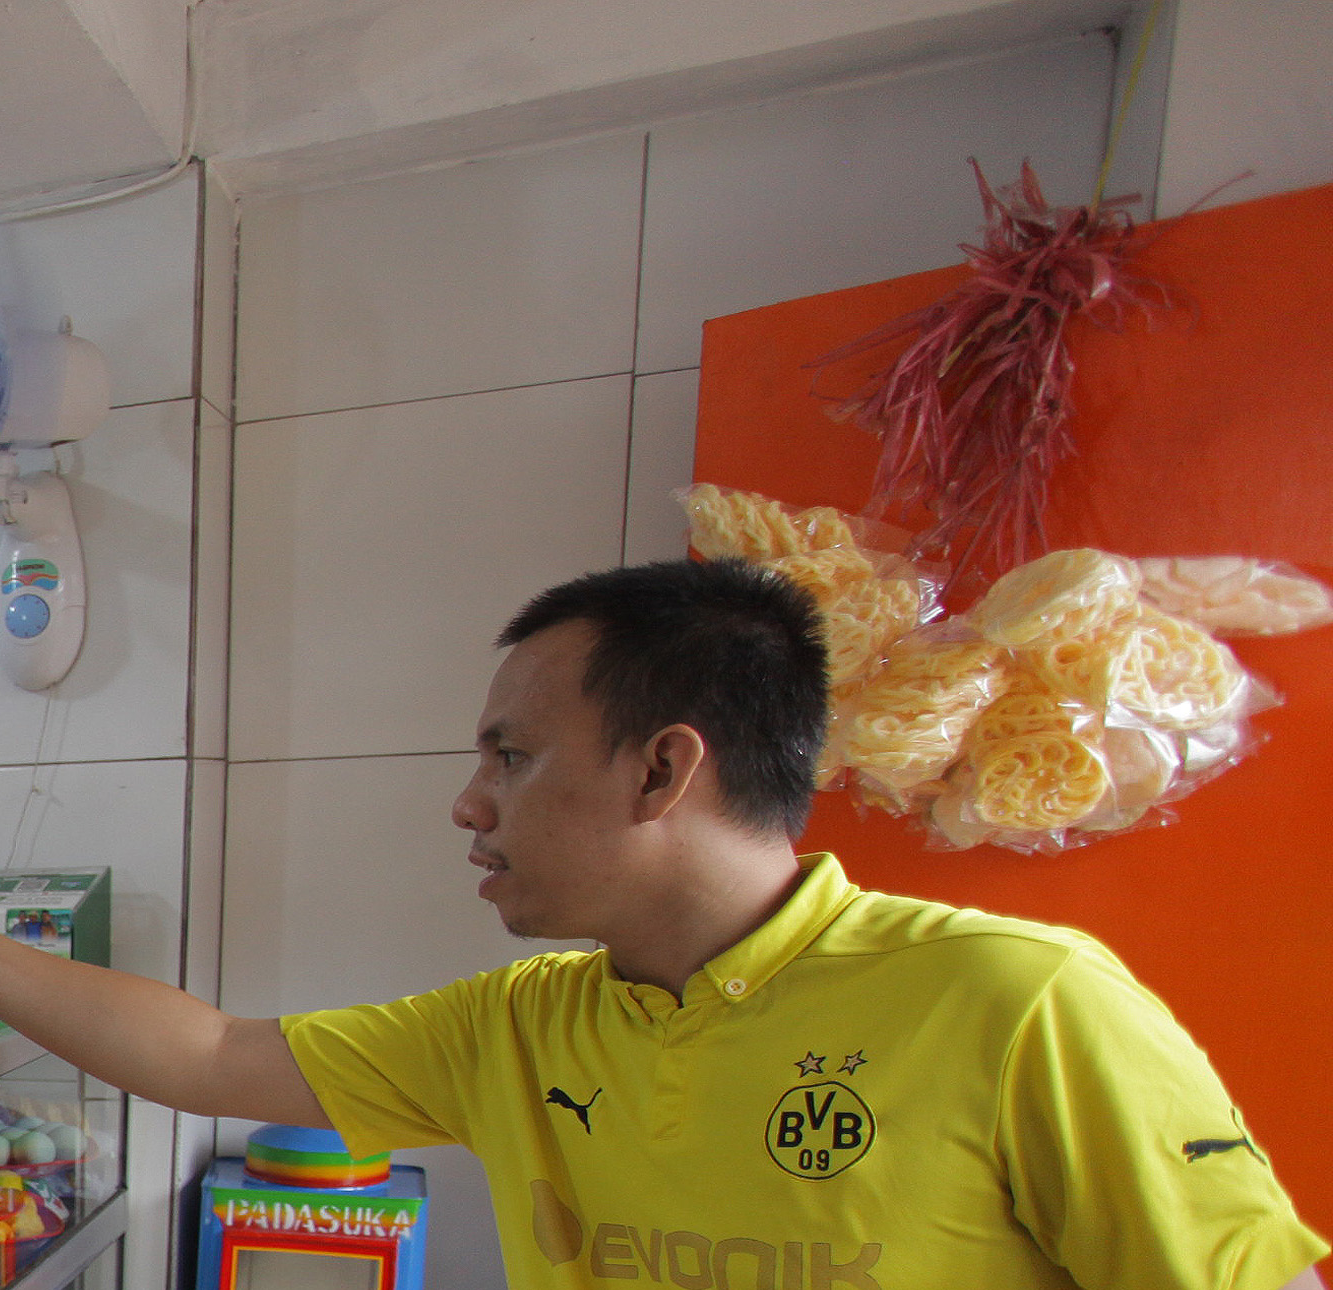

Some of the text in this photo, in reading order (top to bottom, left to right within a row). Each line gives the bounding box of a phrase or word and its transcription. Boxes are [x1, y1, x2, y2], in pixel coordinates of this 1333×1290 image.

[778, 1091, 862, 1151] BVB
[798, 1149, 831, 1172] 09
[225, 1199, 413, 1237] PADASUKA
